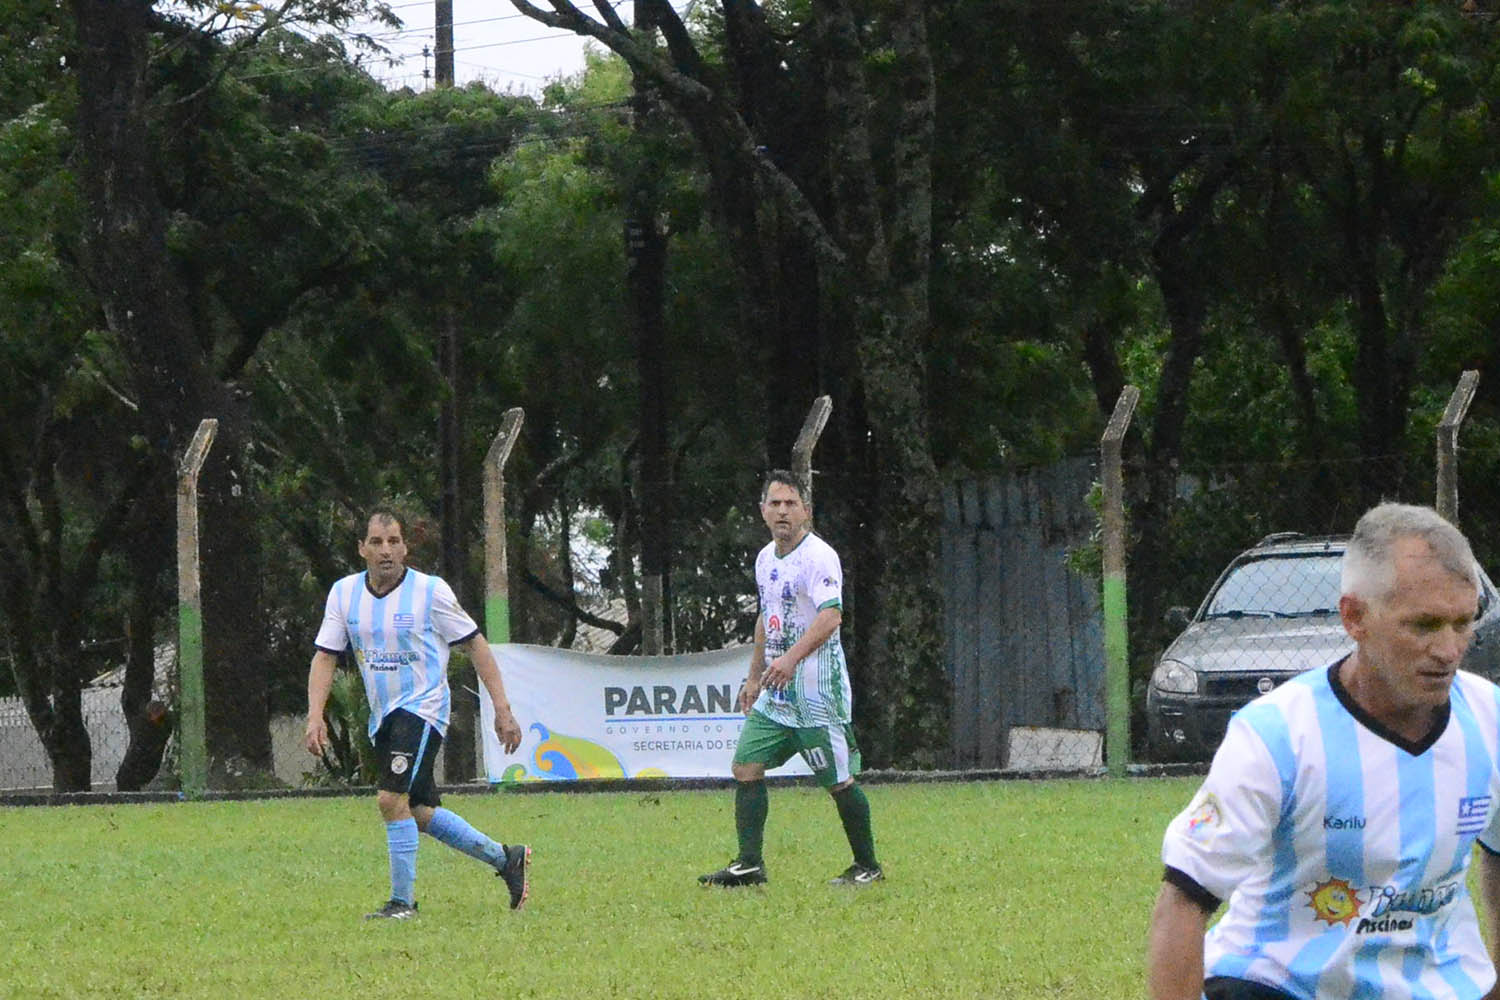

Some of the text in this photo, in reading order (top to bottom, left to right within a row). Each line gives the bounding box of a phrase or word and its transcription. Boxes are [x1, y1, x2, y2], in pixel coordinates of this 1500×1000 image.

[606, 725, 689, 735] GOVERNO
[703, 724, 724, 734] DO
[633, 740, 704, 752] SECRETARIA
[706, 739, 724, 750] DO
